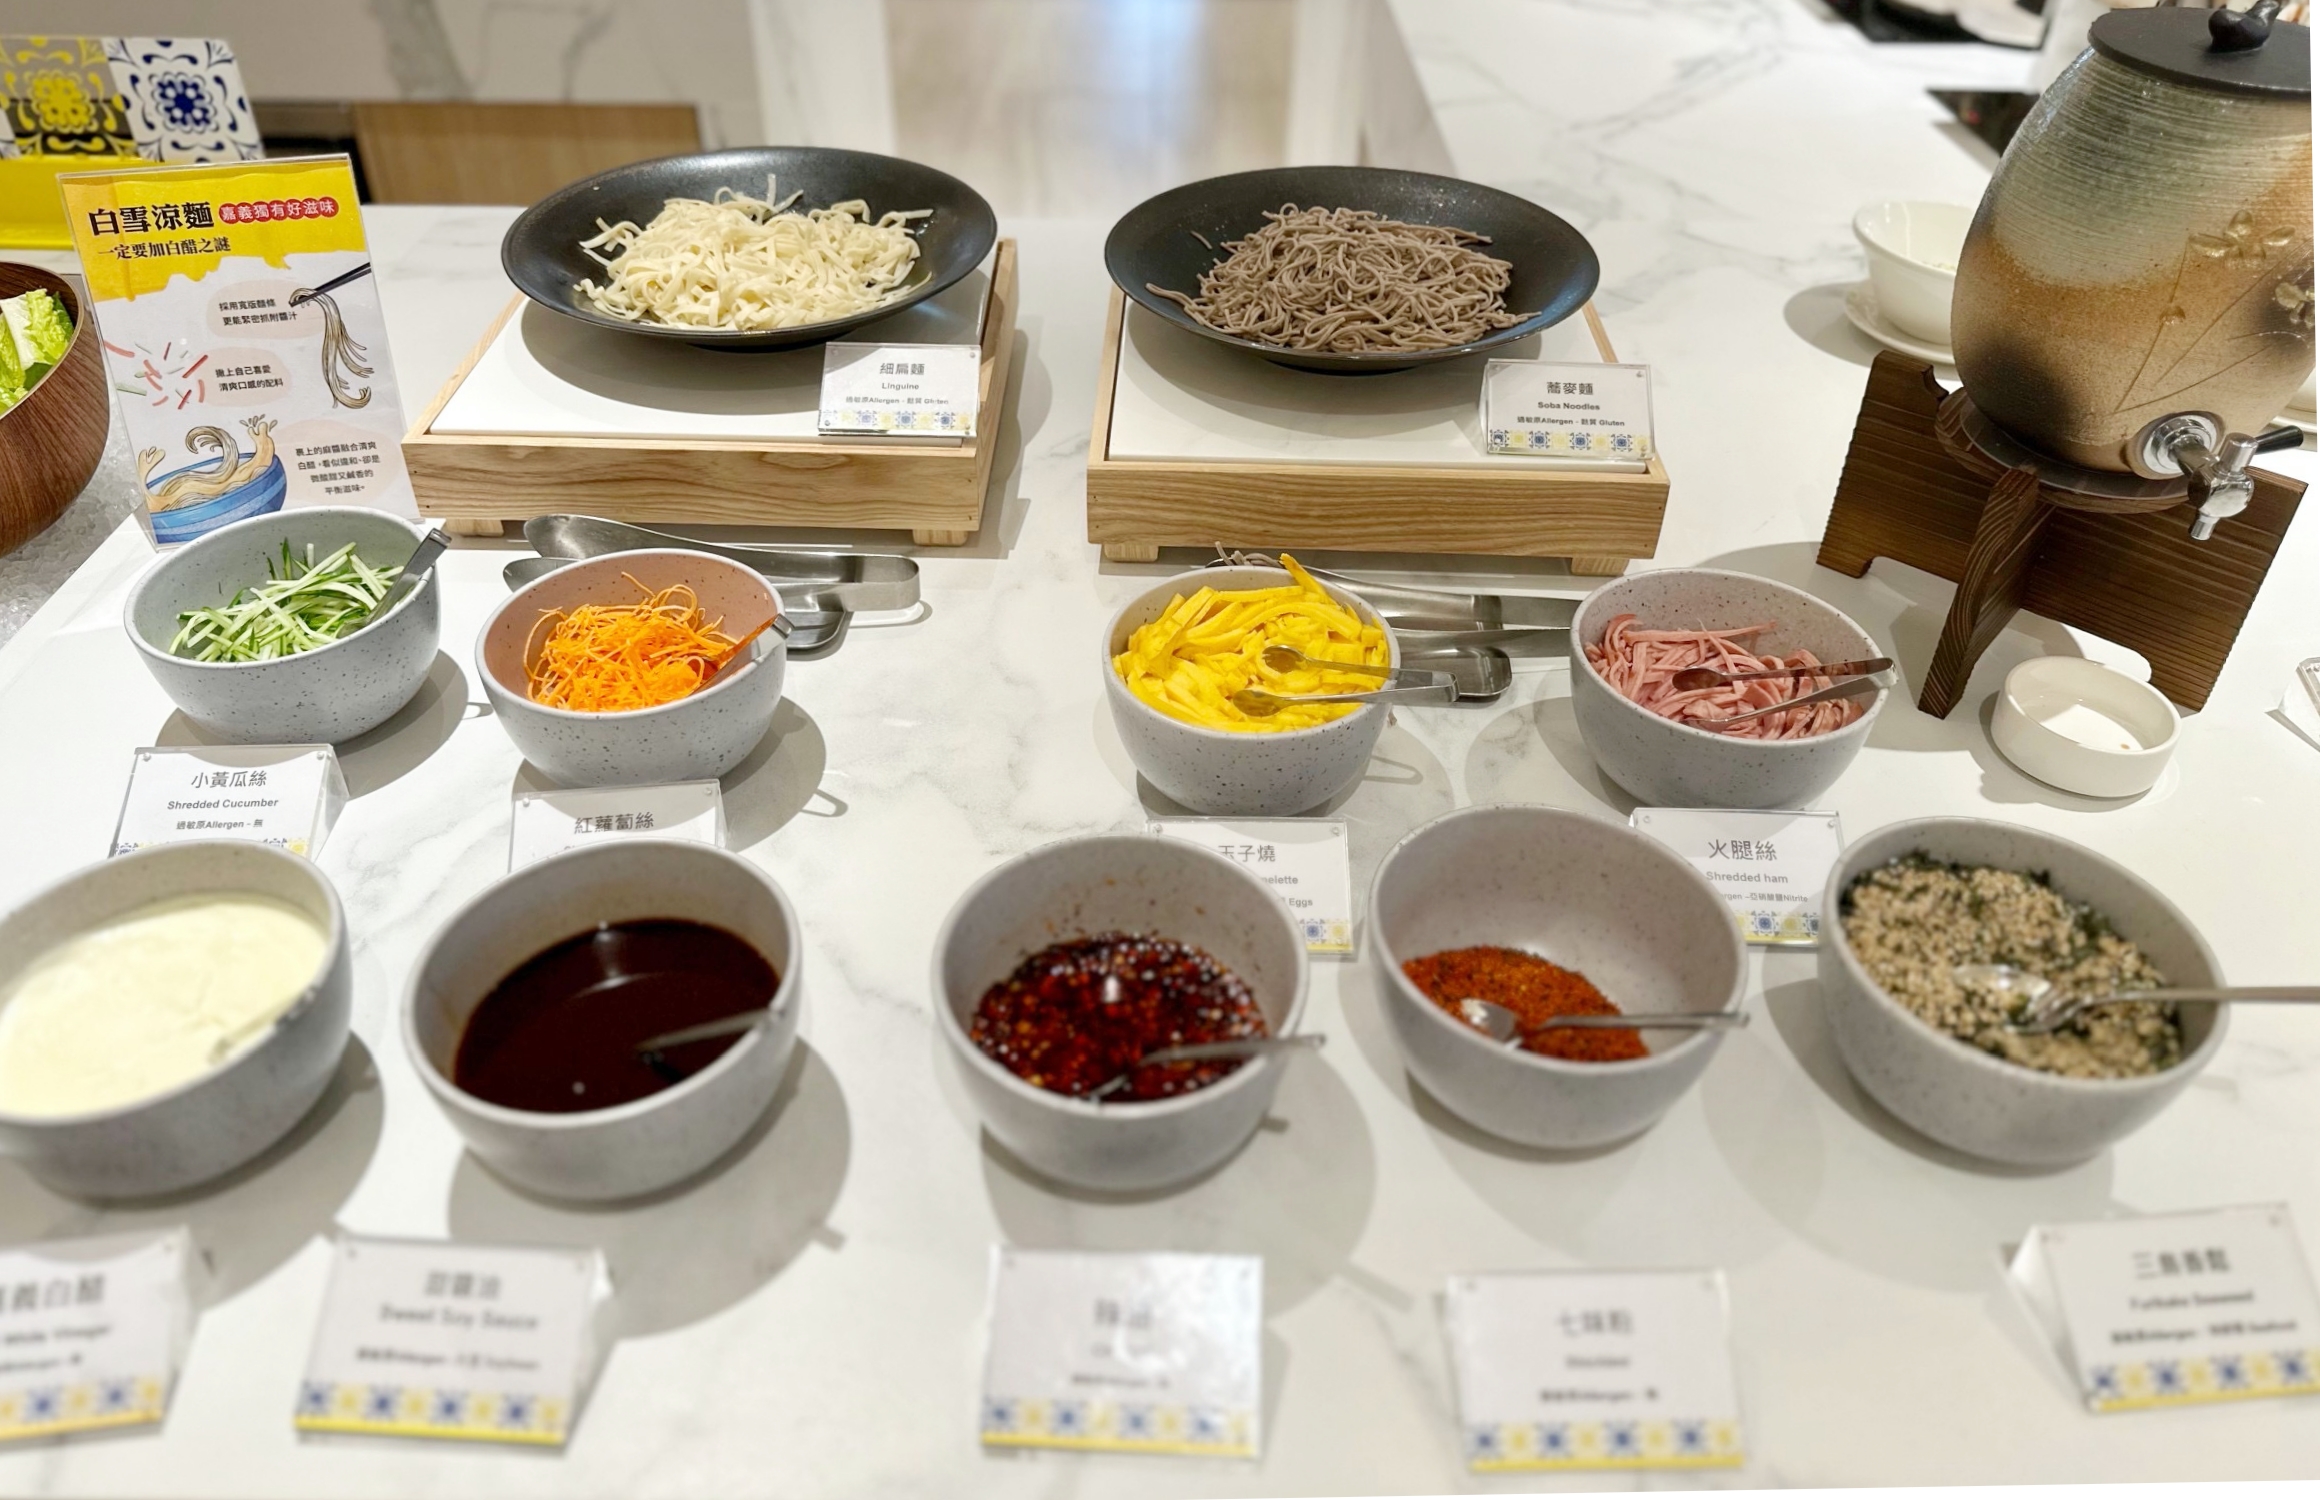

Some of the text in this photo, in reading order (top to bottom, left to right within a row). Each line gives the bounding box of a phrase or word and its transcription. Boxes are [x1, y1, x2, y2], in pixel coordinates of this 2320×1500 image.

[220, 200, 335, 221] 嘉義獨有好滋味
[88, 201, 215, 237] 白雪涼麵
[98, 236, 231, 260] 一定要加白醋之謎
[879, 362, 925, 375] 細扁麵
[881, 382, 919, 391] Linguine
[1546, 381, 1593, 395] 蕎麥麵
[1538, 401, 1600, 411] Soba Noodles
[191, 770, 267, 789] 小黃瓜絲
[167, 798, 279, 810] Shredded Cucumber
[574, 811, 654, 834] 紅蘿蔔絲
[1708, 839, 1778, 861] 火腿絲
[1706, 871, 1788, 883] Shredded ham
[1288, 897, 1314, 908] Eggs
